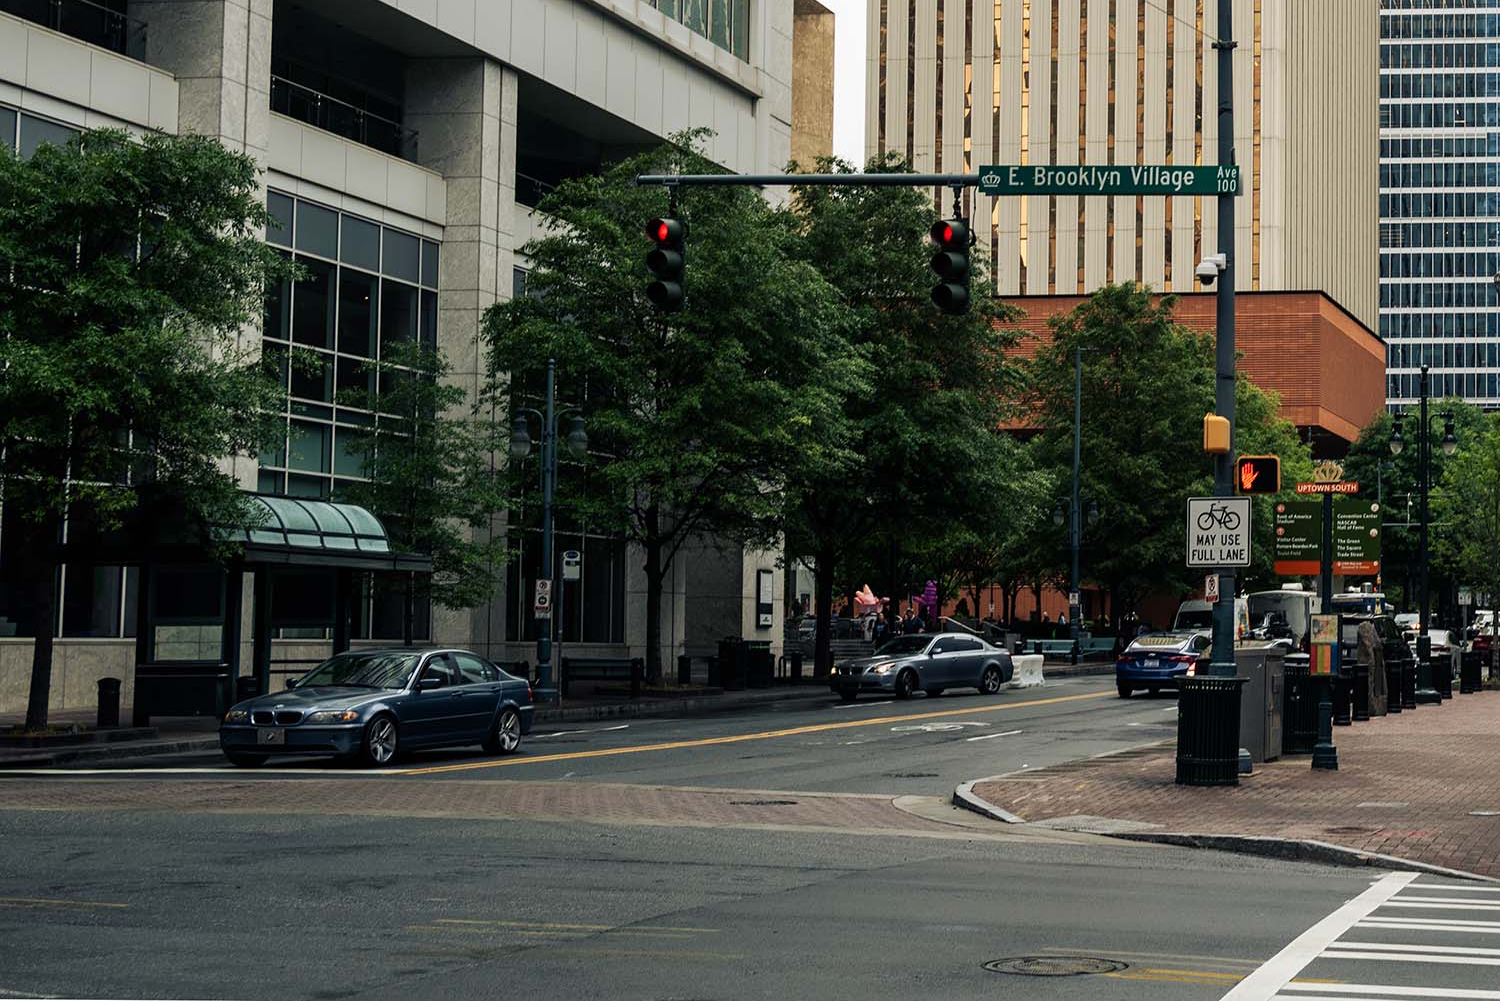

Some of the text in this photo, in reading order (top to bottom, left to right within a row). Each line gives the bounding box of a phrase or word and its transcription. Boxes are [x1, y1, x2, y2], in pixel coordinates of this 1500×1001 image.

[1008, 166, 1195, 192] E. Brooklyn Village
[1216, 167, 1238, 179] Ave
[1216, 179, 1237, 192] 100
[1297, 483, 1358, 493] UPTOWN SOUTH
[1196, 534, 1241, 546] MAY USE
[1191, 549, 1245, 561] FULL LANE
